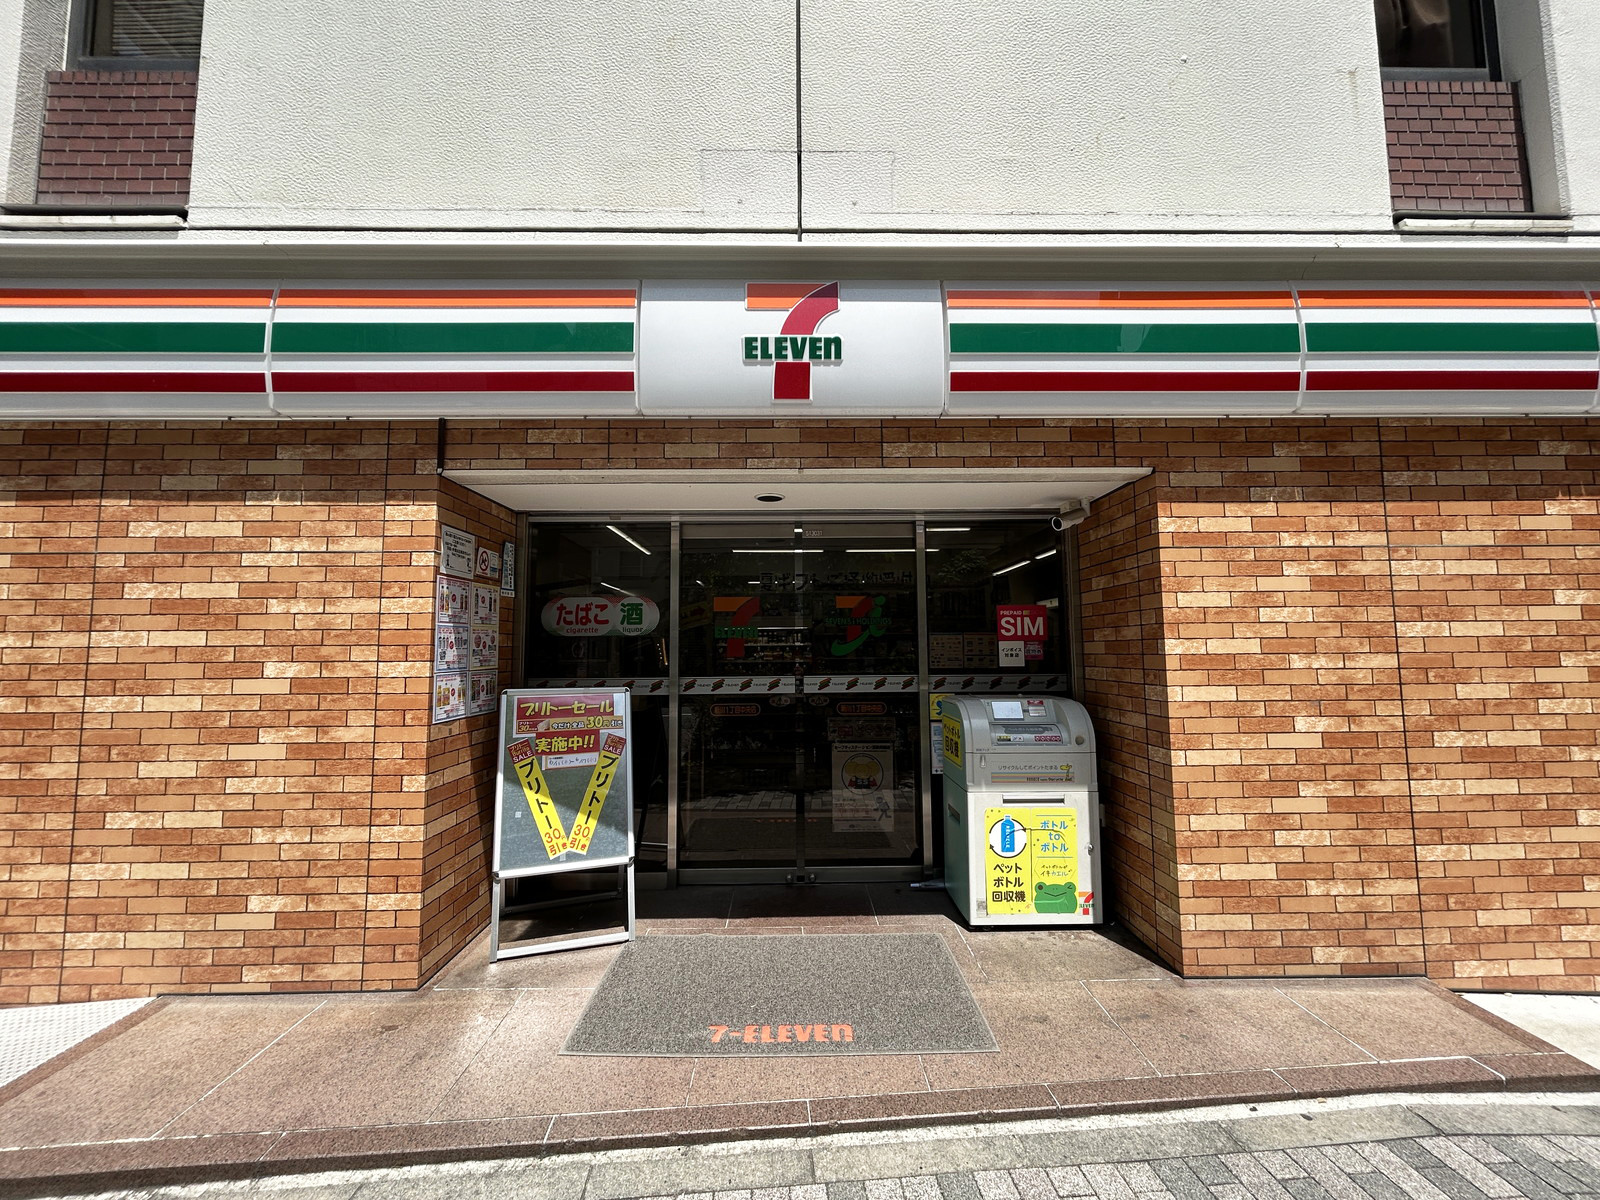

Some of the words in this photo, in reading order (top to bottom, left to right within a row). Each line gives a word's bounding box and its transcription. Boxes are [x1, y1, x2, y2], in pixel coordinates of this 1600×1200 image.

[556, 602, 609, 626] たばこ
[620, 602, 644, 625] 酒
[1000, 616, 1044, 637] SIM
[519, 699, 614, 716] ブリトーセール
[603, 744, 621, 755] SALE
[945, 735, 959, 758] 回収機
[513, 750, 533, 763] SALE
[519, 758, 552, 830] ブリトー
[585, 755, 619, 825] ブリトー
[1040, 820, 1068, 830] ボトル
[1048, 832, 1061, 841] to
[549, 842, 567, 856] 引き
[570, 837, 587, 851] 引き
[1040, 843, 1069, 853] ボトル
[993, 862, 1023, 874] ペット
[993, 876, 1024, 888] ボトル
[992, 890, 1026, 902] 回収機
